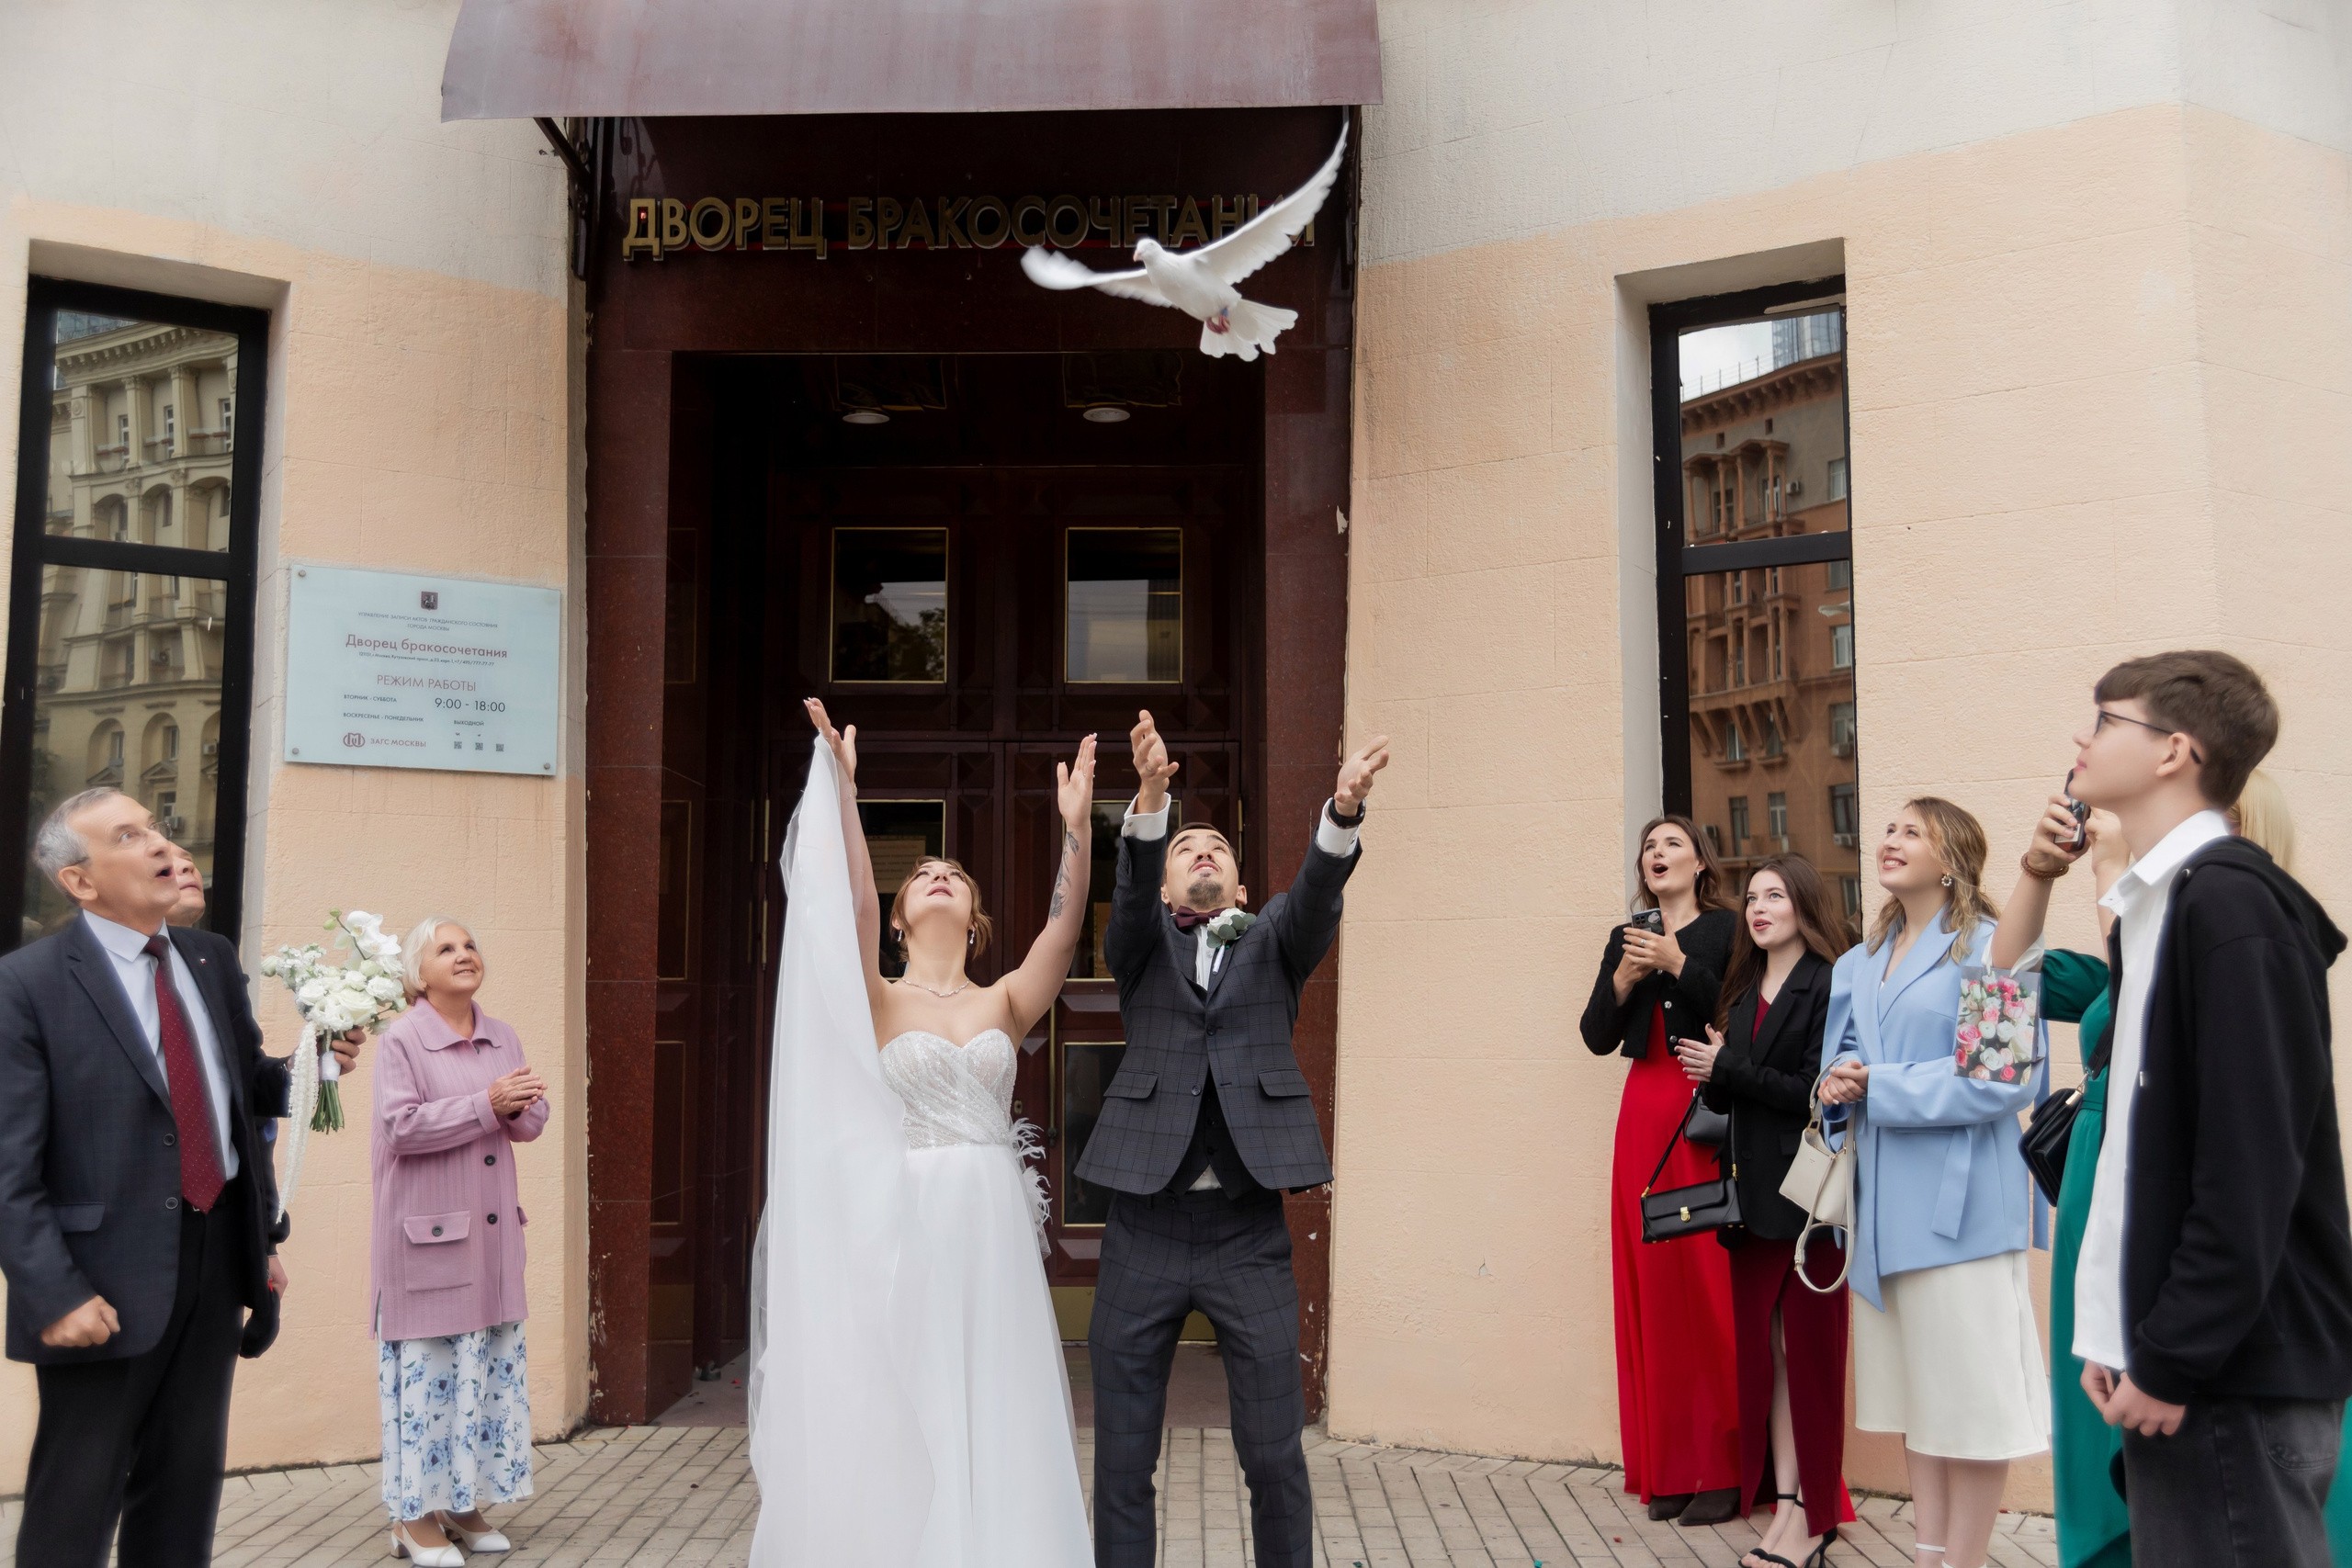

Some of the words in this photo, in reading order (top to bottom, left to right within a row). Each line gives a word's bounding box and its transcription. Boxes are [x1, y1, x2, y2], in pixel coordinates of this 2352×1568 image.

[622, 196, 827, 262] ДВОРЕЦ
[846, 193, 1316, 251] БРАКОСОЧЕТАН
[357, 611, 390, 619] УПРАВЛЕНИЕ
[429, 618, 469, 626] ГРАЖДАНСКОГО
[345, 633, 398, 651] Дворец
[401, 637, 507, 659] бракосочетания
[377, 674, 424, 688] РЕЖИМ
[428, 678, 477, 692] РАБОТЫ
[372, 695, 398, 704] СУББОТА
[435, 697, 462, 710] 9:00
[474, 699, 506, 713] 18:00
[343, 712, 380, 720] ВОСКРЕСЕНЬЕ
[384, 715, 424, 723] ПОНЕДЕЛЬНИК
[369, 738, 390, 746] ЗАГС
[390, 739, 427, 748] МОСКВЫ
